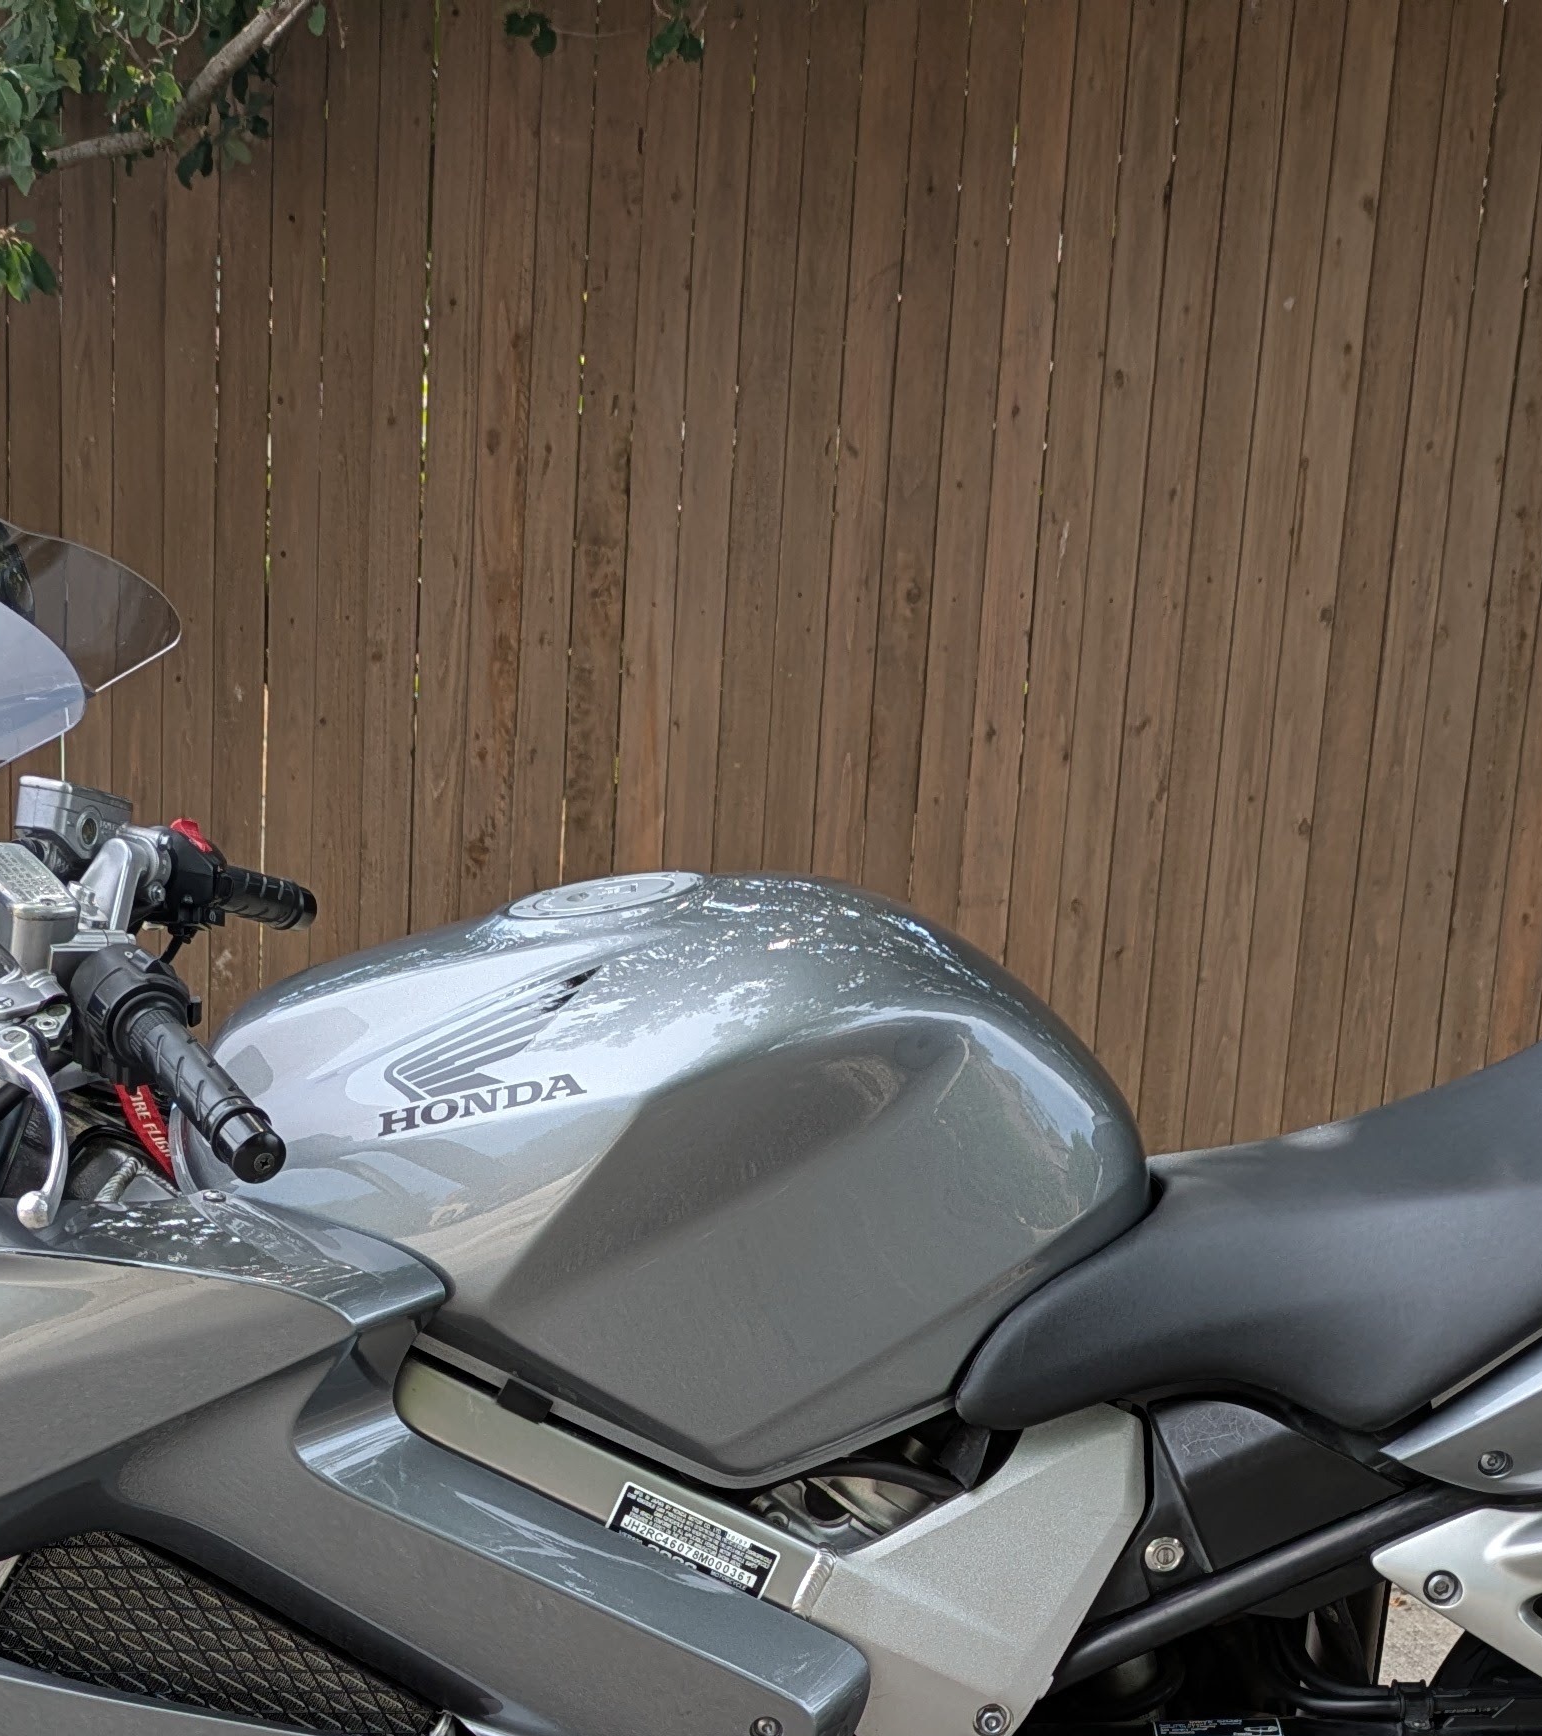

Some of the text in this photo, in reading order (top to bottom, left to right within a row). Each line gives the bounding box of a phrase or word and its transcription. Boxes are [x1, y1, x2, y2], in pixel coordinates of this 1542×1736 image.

[377, 1072, 588, 1137] HONDA
[622, 1516, 753, 1586] JH2RC46078M000361
[708, 1569, 748, 1592] MOTORCYCLE
